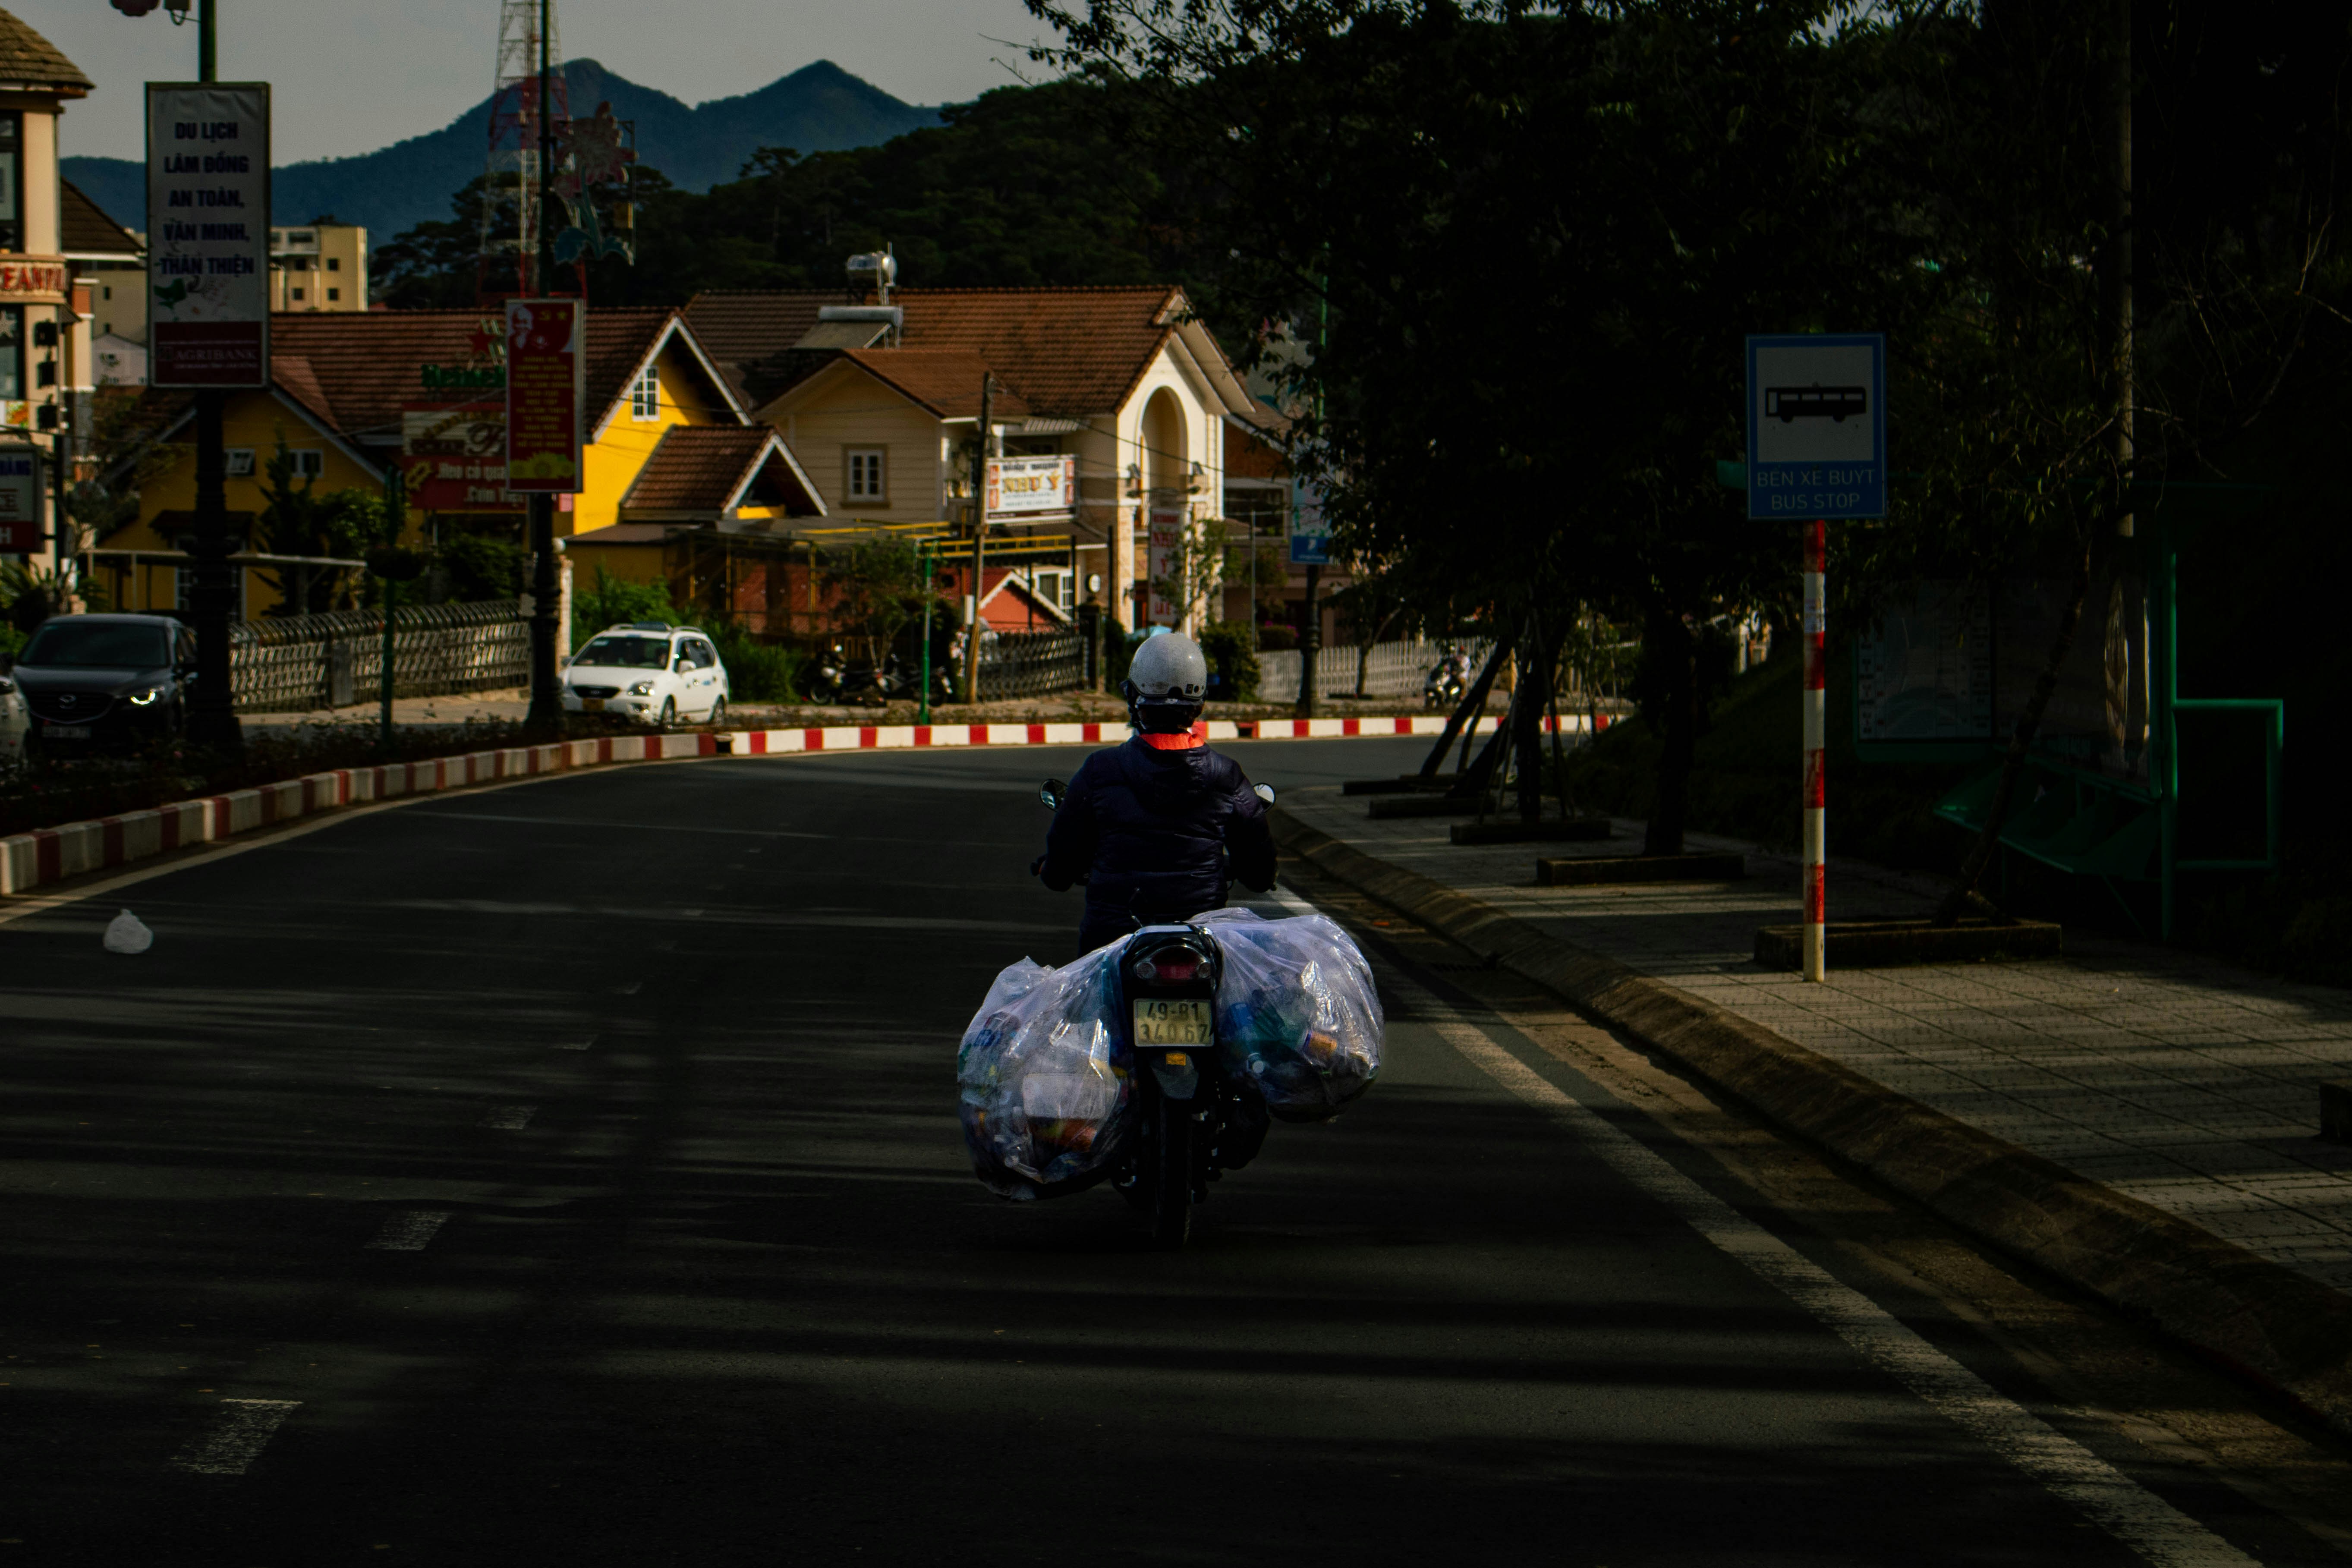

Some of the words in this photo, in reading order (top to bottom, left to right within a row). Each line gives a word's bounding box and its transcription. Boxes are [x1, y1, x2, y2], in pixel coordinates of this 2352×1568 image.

[175, 123, 196, 139] DU
[202, 123, 238, 142] LỊCH
[164, 152, 199, 173] LÂM
[205, 151, 249, 173] ĐỒNG
[169, 190, 192, 206] AN
[197, 186, 244, 208] TOÀN,
[202, 224, 250, 242] MINH,
[207, 254, 254, 277] THIỆN
[1757, 464, 1794, 487] BẾN
[1800, 469, 1823, 486] XE
[1828, 464, 1876, 485] BUÝT
[1771, 494, 1808, 510] BUS
[1814, 492, 1860, 509] STOP
